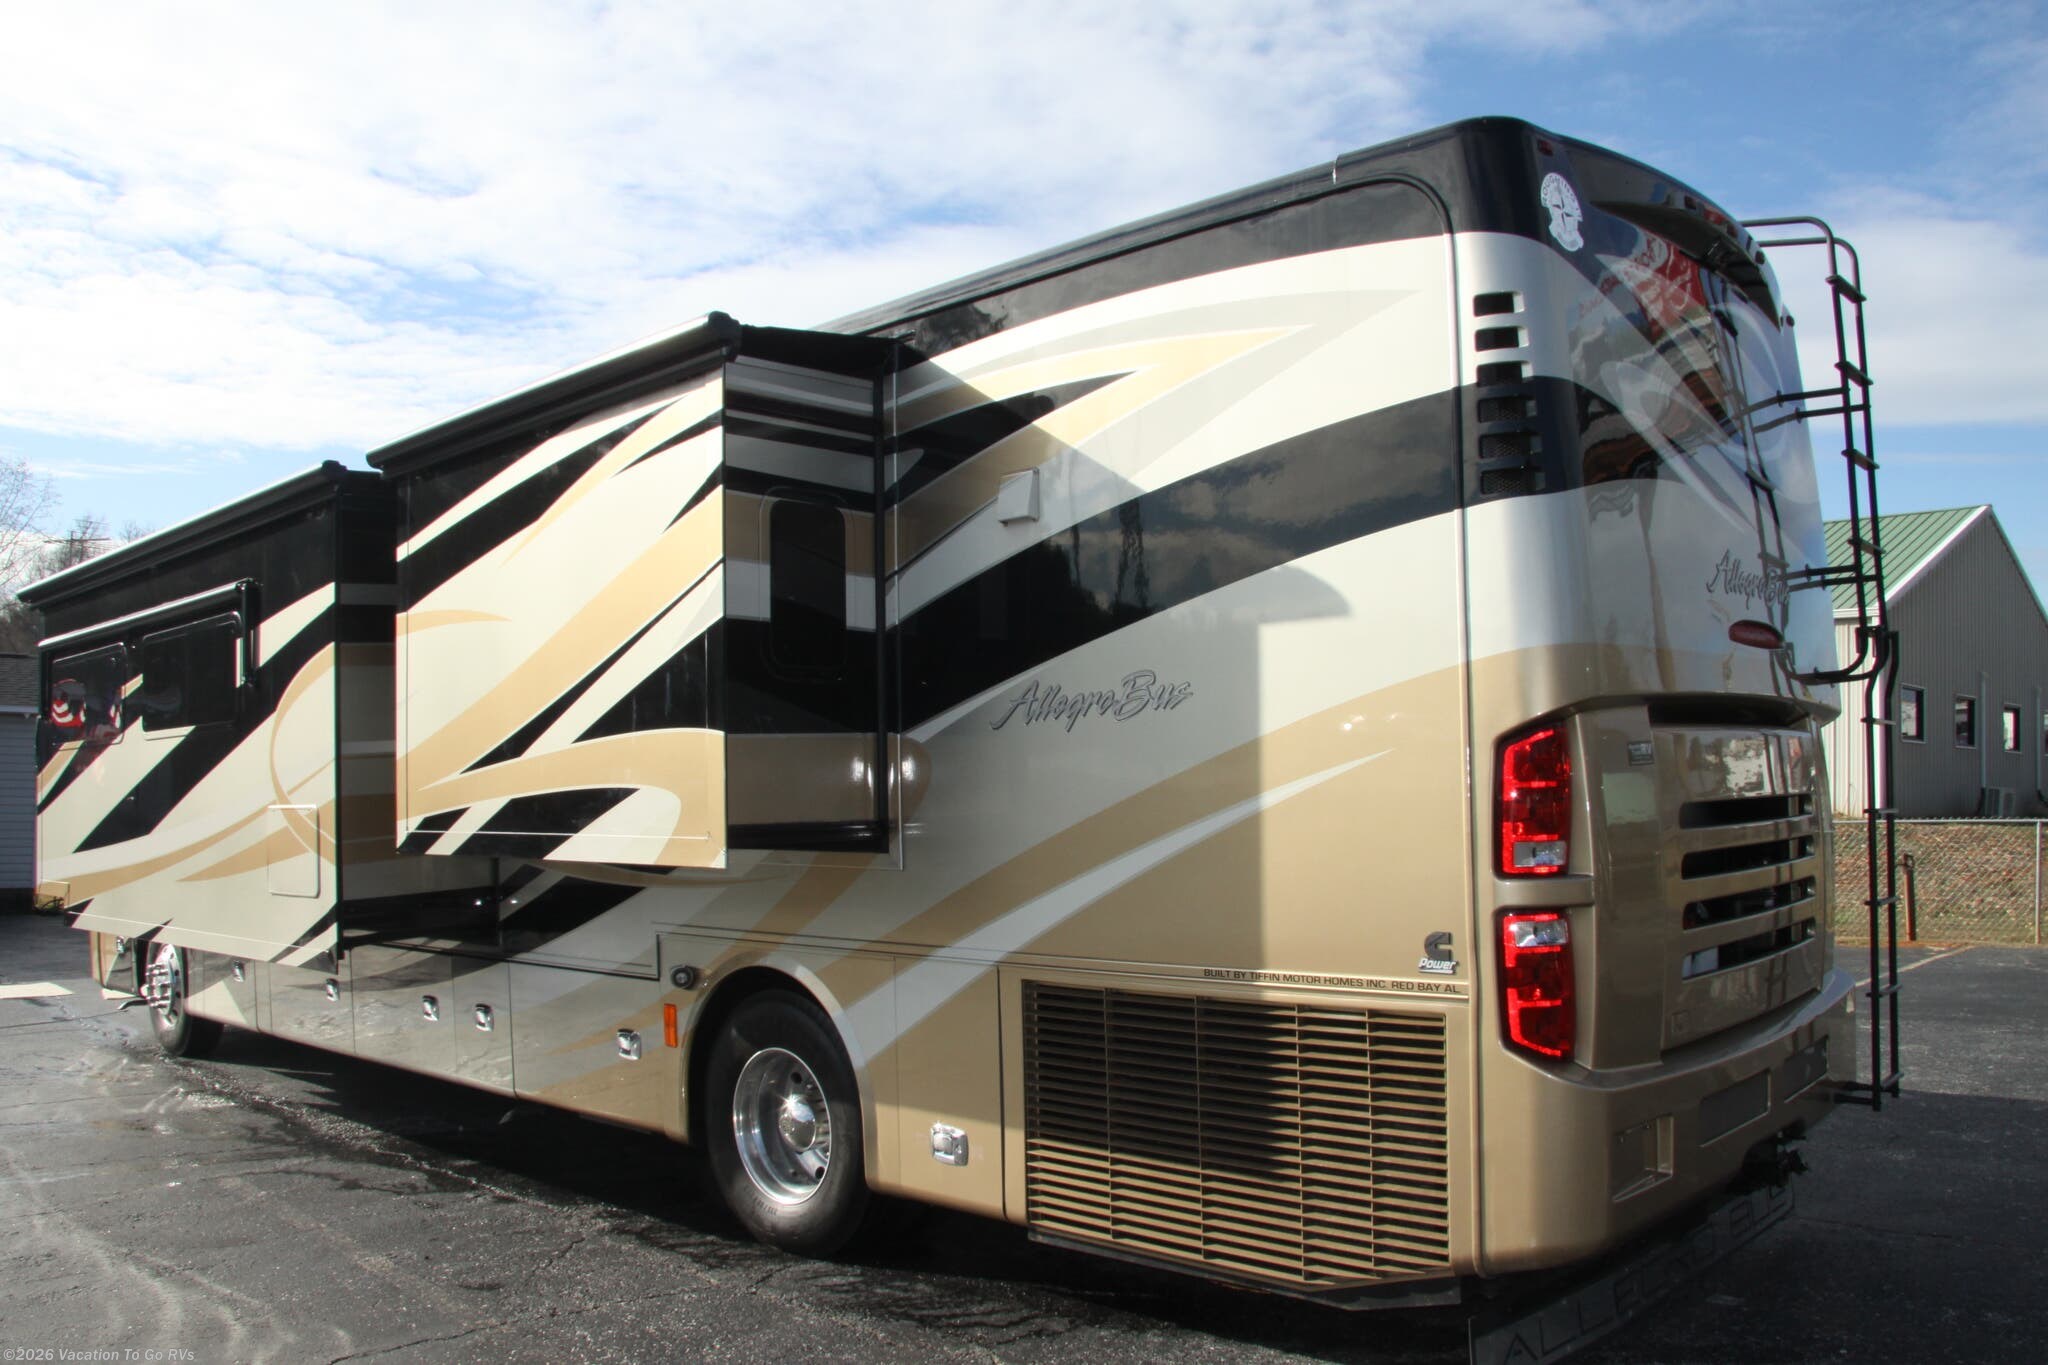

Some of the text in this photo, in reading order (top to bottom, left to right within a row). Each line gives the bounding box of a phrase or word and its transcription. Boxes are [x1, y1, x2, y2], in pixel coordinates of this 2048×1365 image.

[1114, 669, 1195, 722] Bus
[1418, 957, 1457, 970] Power
[1203, 968, 1230, 978] BUILT
[1233, 970, 1247, 979] BY
[1250, 972, 1280, 981] TIFFIN
[1282, 973, 1321, 984] MOTOR
[1323, 976, 1364, 987] HOMES
[1391, 980, 1414, 990] RED
[1417, 982, 1441, 992] BAY
